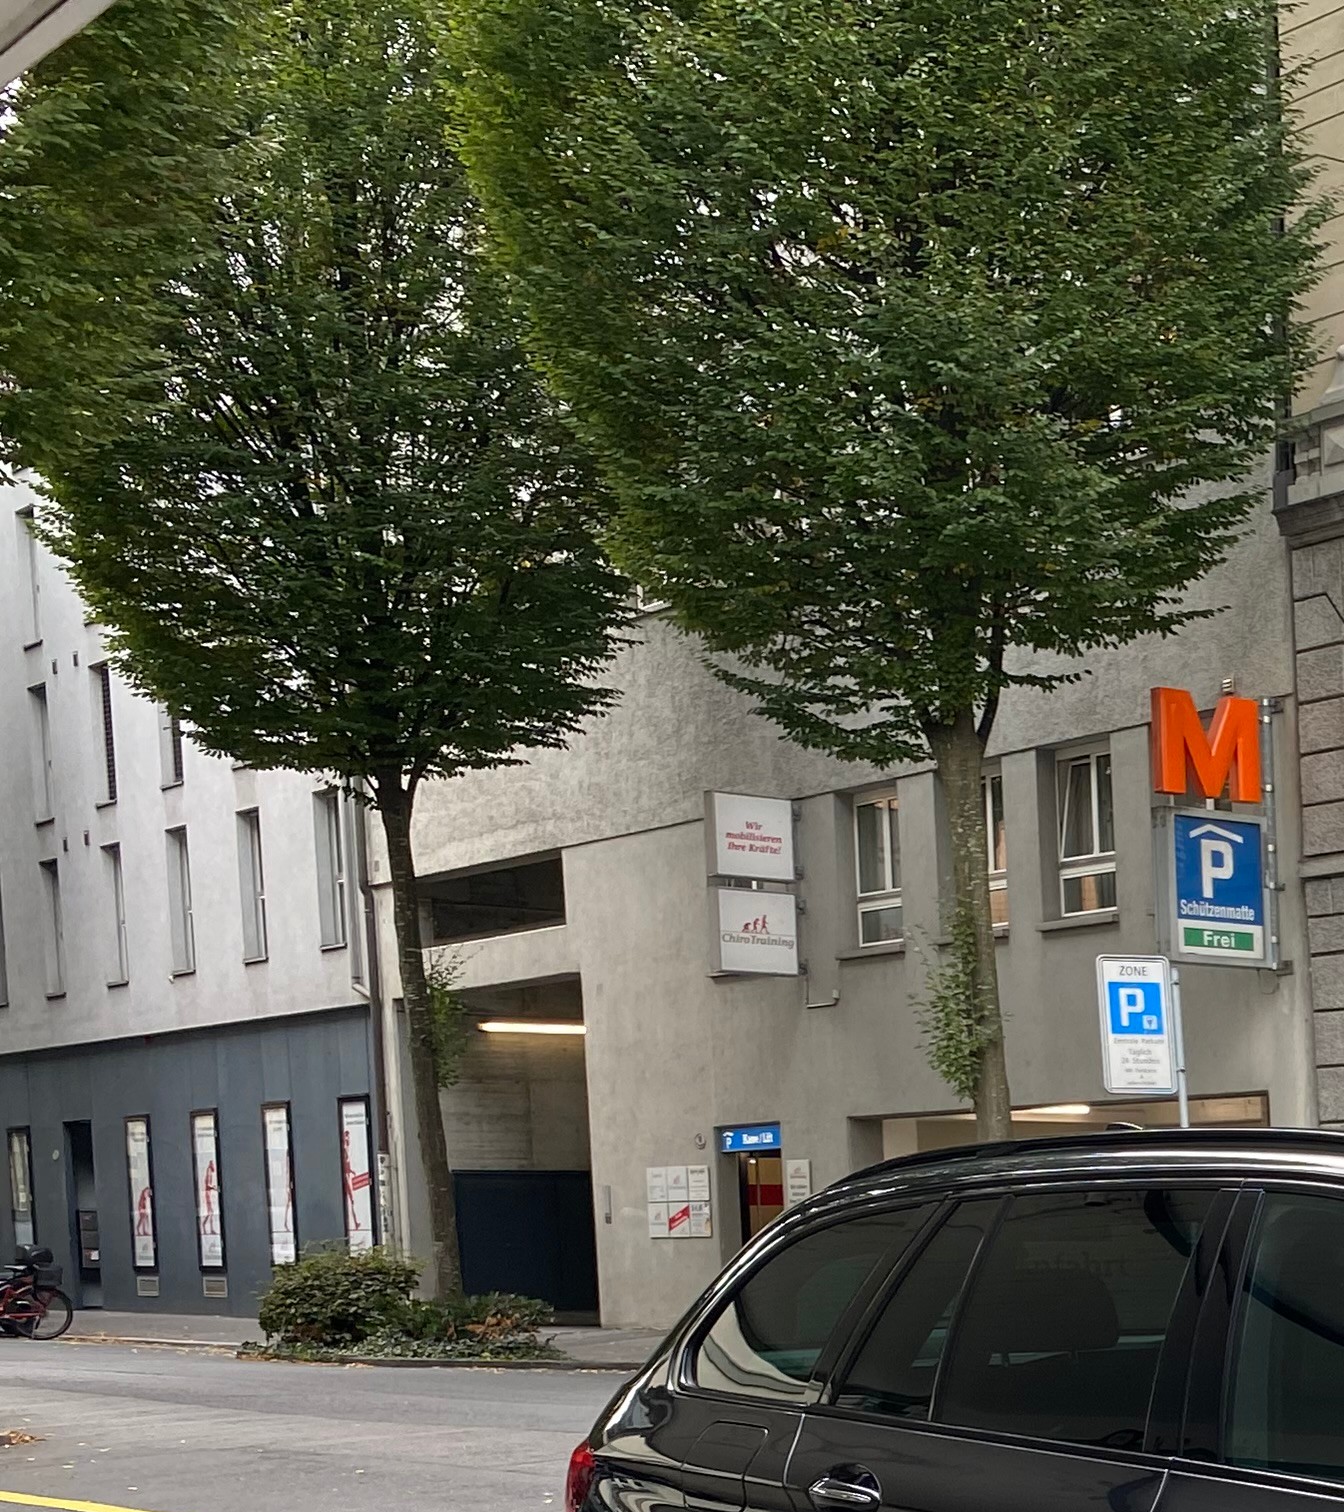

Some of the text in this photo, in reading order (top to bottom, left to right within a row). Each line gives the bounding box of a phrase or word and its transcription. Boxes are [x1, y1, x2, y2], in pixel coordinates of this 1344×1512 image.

[1151, 687, 1262, 803] M
[745, 821, 762, 831] Wir
[725, 831, 782, 844] mobilisieren
[727, 842, 782, 855] Ihre Kräfte!
[1200, 838, 1235, 899] P
[1180, 899, 1255, 921] Schützenmatte
[722, 933, 795, 949] ChiroTraining
[1202, 931, 1236, 948] Frei
[1119, 966, 1148, 976] ZONE
[1118, 987, 1145, 1027] P
